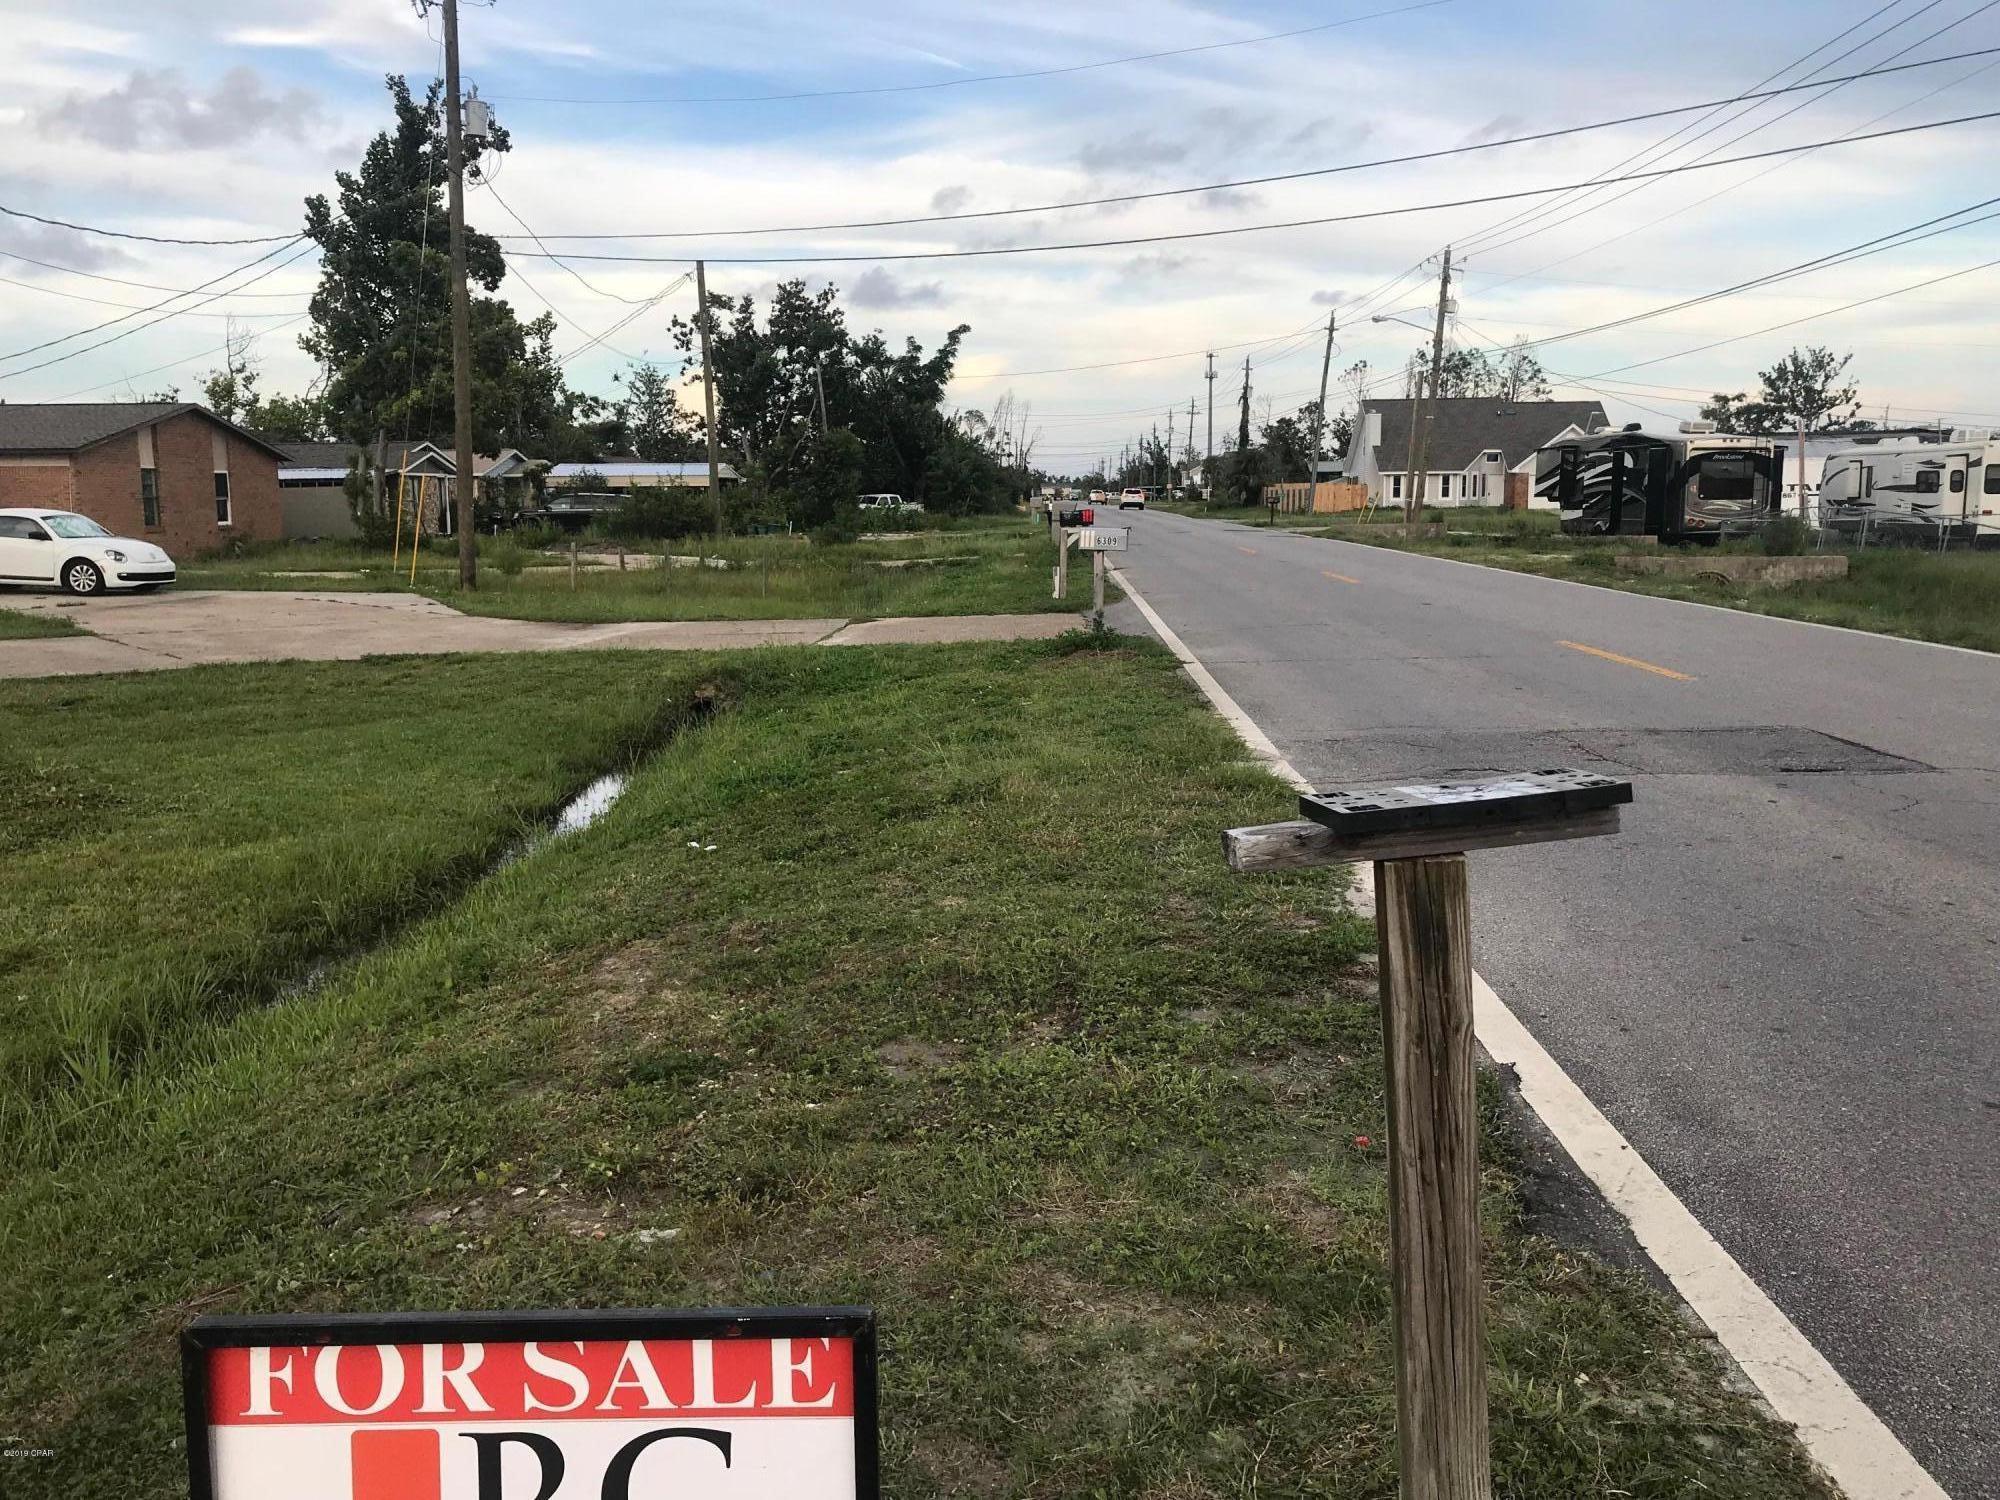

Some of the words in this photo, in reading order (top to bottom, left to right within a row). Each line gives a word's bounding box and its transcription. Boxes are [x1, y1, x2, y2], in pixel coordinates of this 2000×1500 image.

[1096, 536, 1117, 546] 6309
[239, 1343, 496, 1416] FOR
[523, 1338, 837, 1412] SALE
